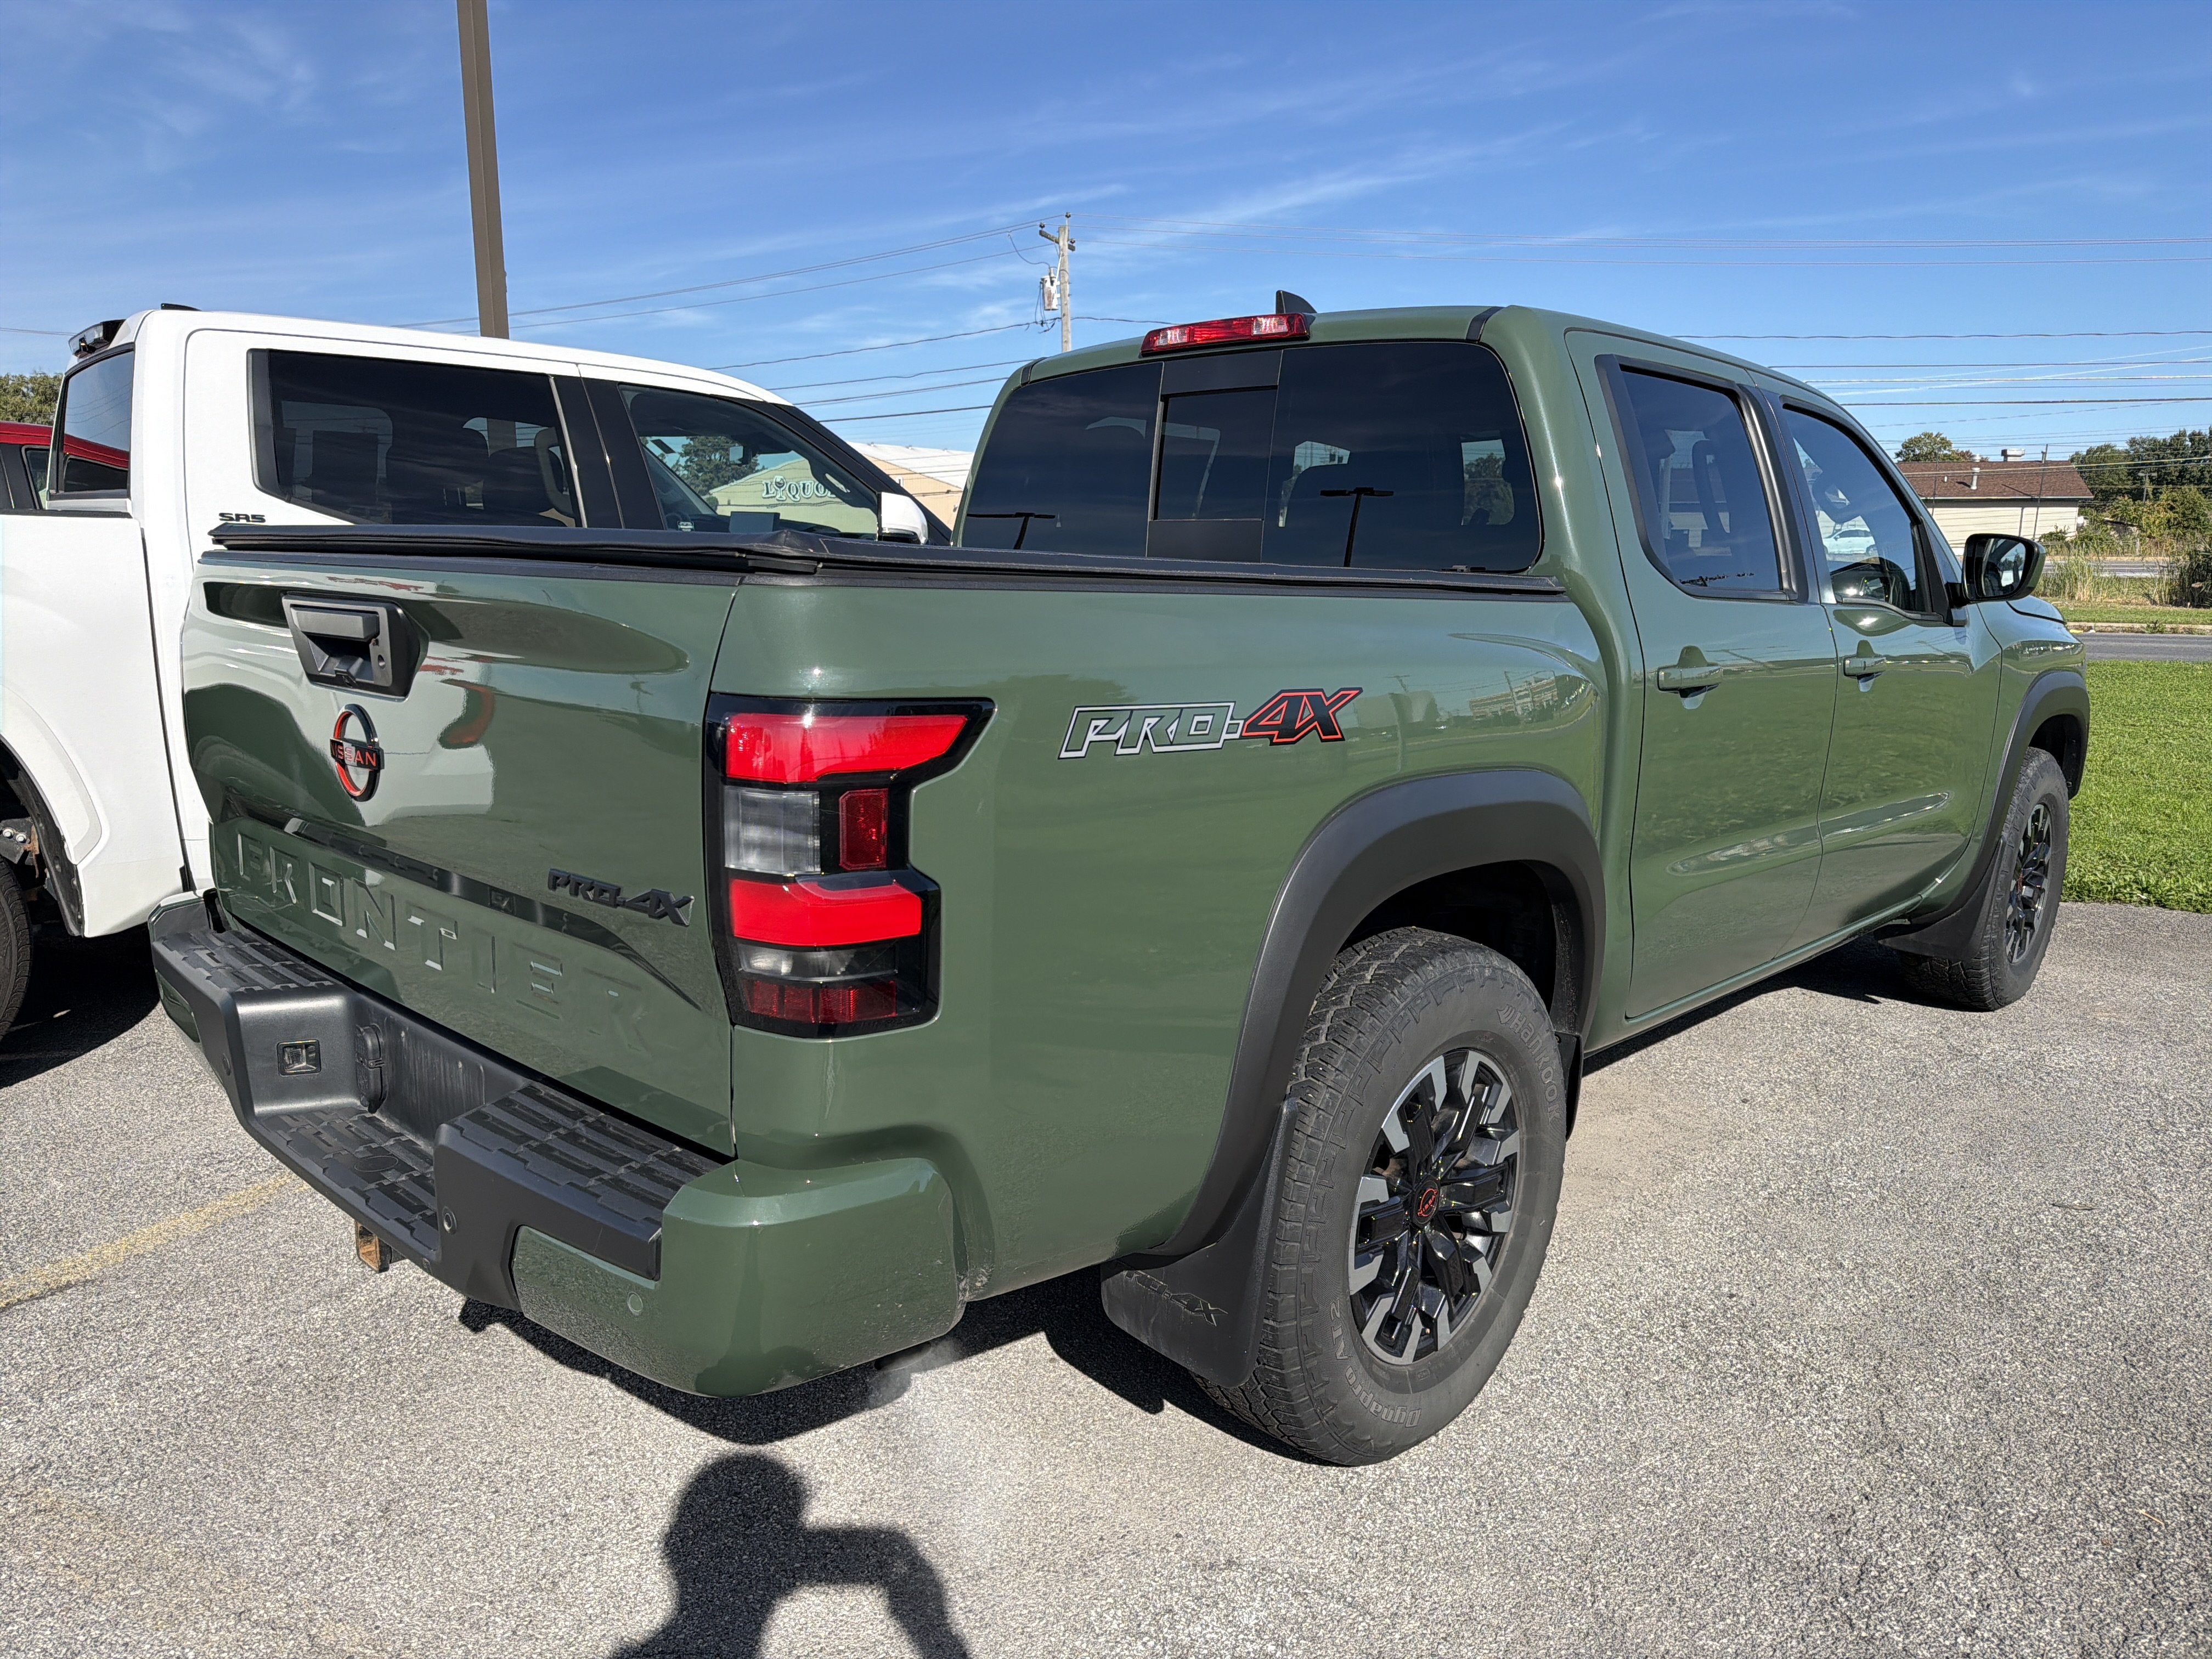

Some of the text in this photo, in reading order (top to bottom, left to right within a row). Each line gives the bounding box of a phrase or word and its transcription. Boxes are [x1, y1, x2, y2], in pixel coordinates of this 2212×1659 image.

[762, 475, 836, 501] LIQUO
[219, 512, 266, 523] SR5
[1058, 687, 1364, 759] PRO-4X
[330, 741, 377, 767] NISSAN
[548, 868, 695, 927] PRO-4X
[1417, 1188, 1438, 1216] NISSAN
[1330, 1297, 1421, 1428] Dynapro AT2
